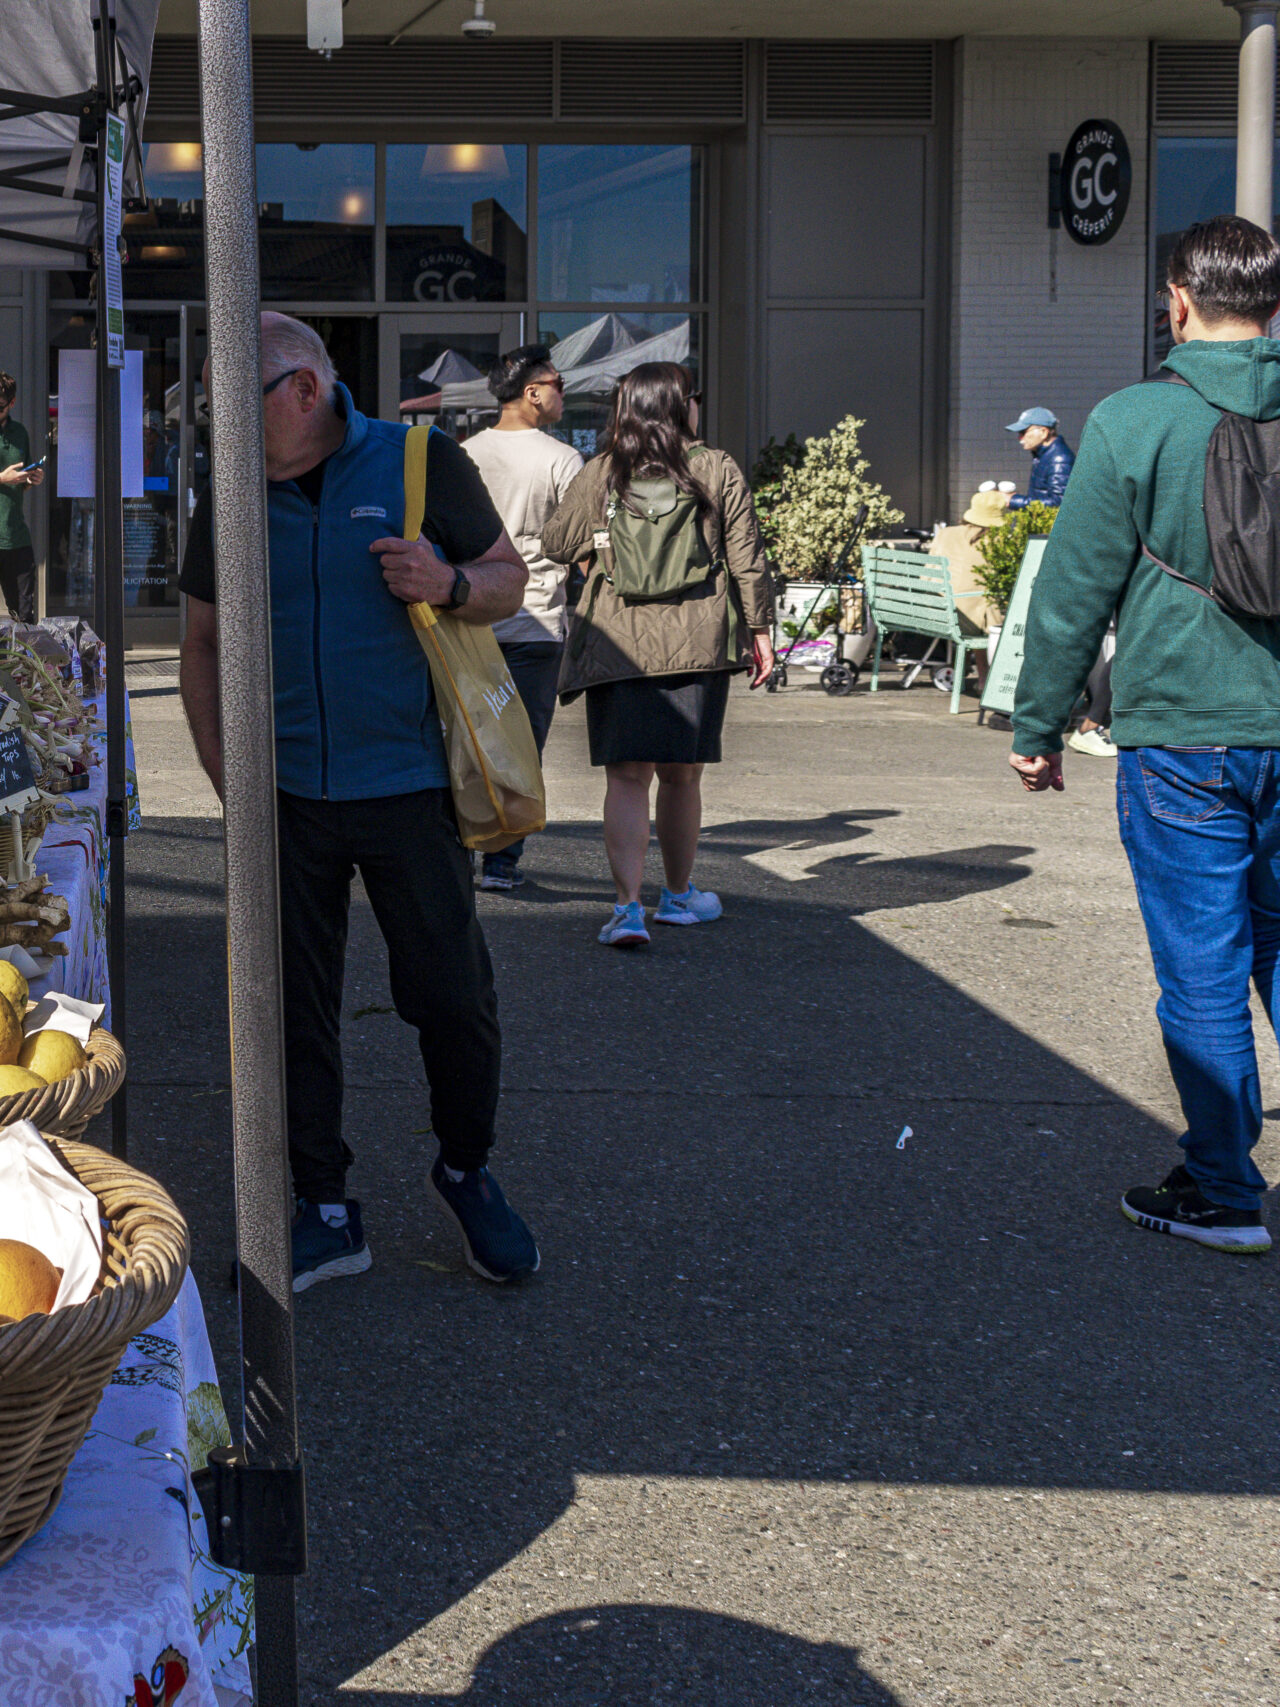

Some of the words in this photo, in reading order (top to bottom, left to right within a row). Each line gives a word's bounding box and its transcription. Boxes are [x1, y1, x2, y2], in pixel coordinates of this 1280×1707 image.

[1075, 130, 1114, 154] GRANDE
[1071, 152, 1117, 209] GC
[419, 253, 472, 268] GRANDE
[414, 270, 477, 303] GC
